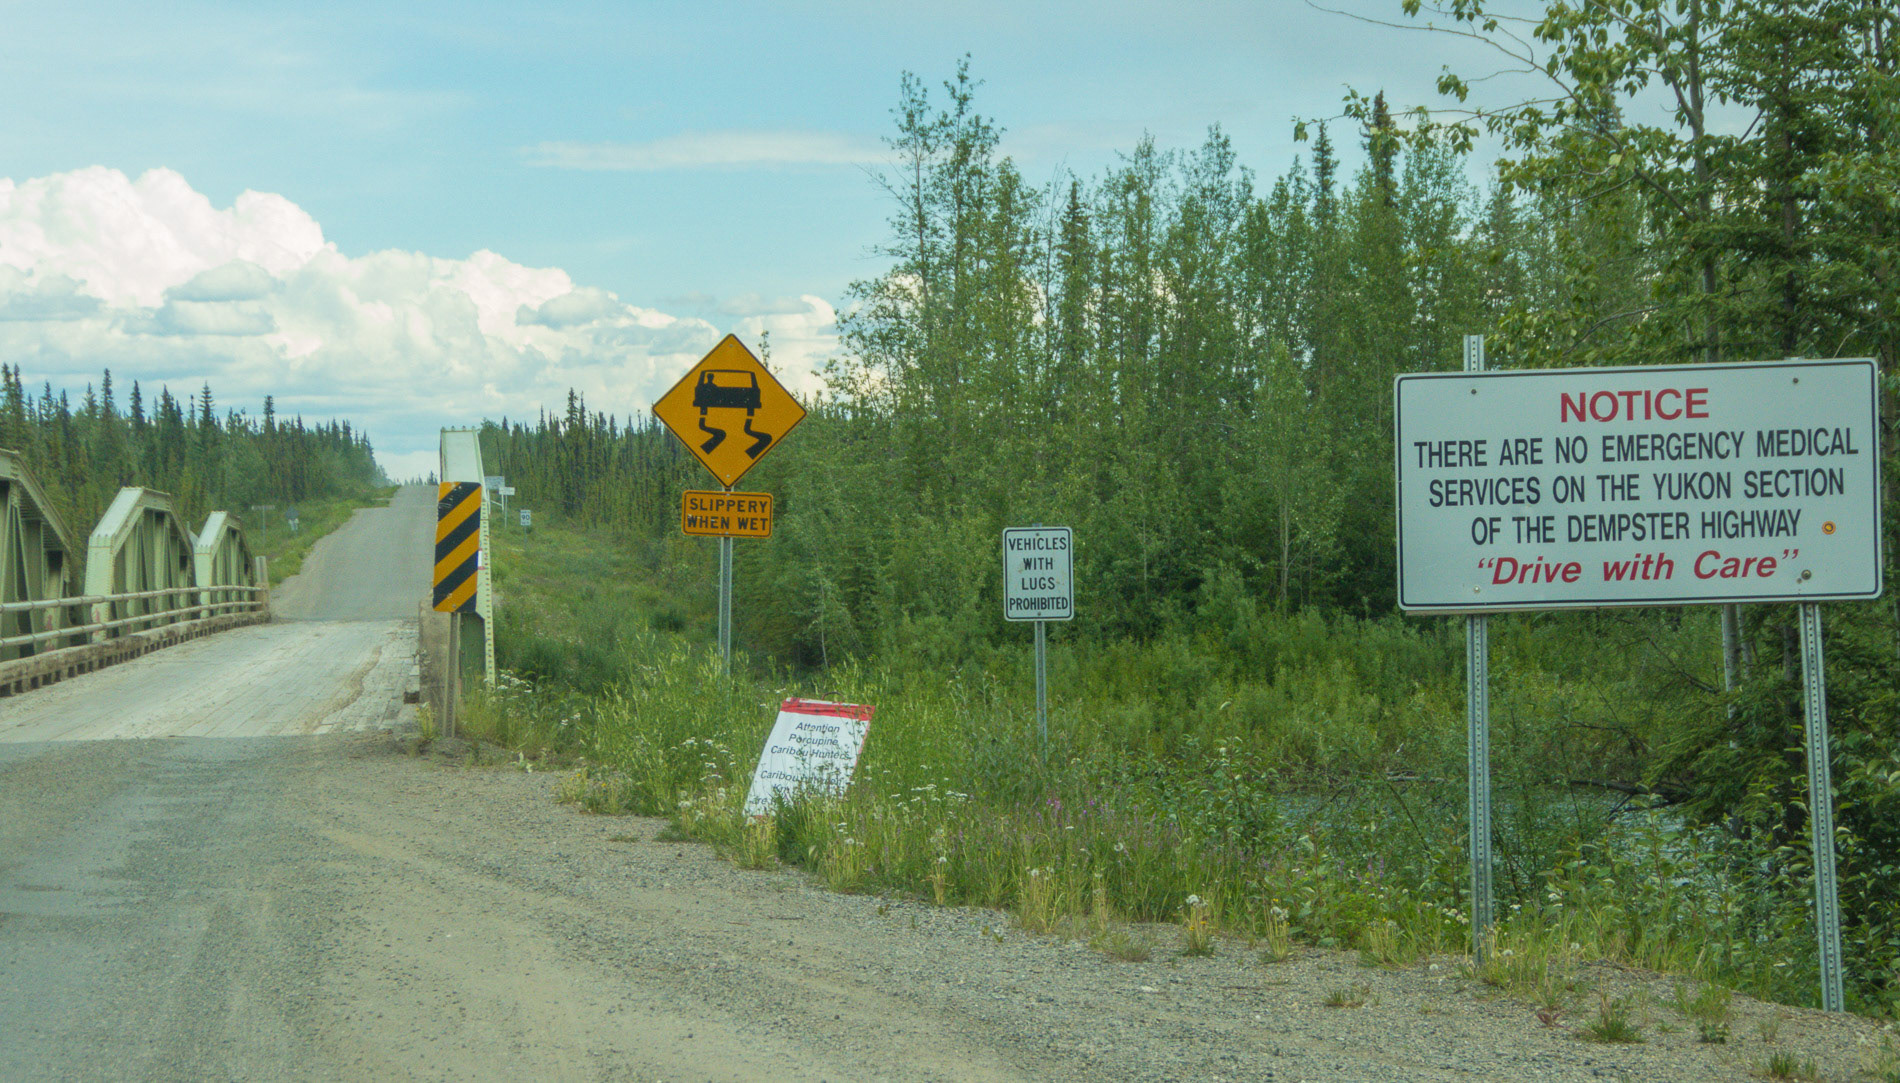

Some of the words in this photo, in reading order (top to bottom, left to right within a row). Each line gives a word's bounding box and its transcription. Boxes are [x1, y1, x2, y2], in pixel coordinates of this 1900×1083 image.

[1560, 387, 1710, 423] NOTICE
[1413, 439, 1488, 469] THERE
[1499, 437, 1544, 466] ARE
[1555, 435, 1588, 464] NO
[1602, 430, 1745, 462] EMERGENCY
[1756, 427, 1859, 458] MEDICAL
[1429, 476, 1541, 508] SERVICES
[1552, 475, 1585, 504] ON
[1596, 473, 1640, 502] THE
[1653, 471, 1732, 501] YUKON
[1743, 467, 1844, 499] SECTION
[689, 497, 768, 513] SLIPPERY
[687, 515, 730, 529] WHEN
[738, 517, 769, 531] WET
[1471, 516, 1502, 545] OF
[1512, 515, 1556, 544] THE
[1567, 511, 1690, 543] DEMPSTER
[1701, 508, 1802, 539] HIGHWAY
[1008, 537, 1067, 551] VEHICLES
[1023, 557, 1053, 570] WITH
[1603, 552, 1675, 582] with
[1021, 577, 1056, 590] LUGS
[1009, 597, 1068, 610] PROHIBITED
[795, 721, 840, 733] Attention
[788, 733, 839, 746] Porcupine
[770, 745, 809, 757] Caribou
[760, 770, 798, 782] Caribou
